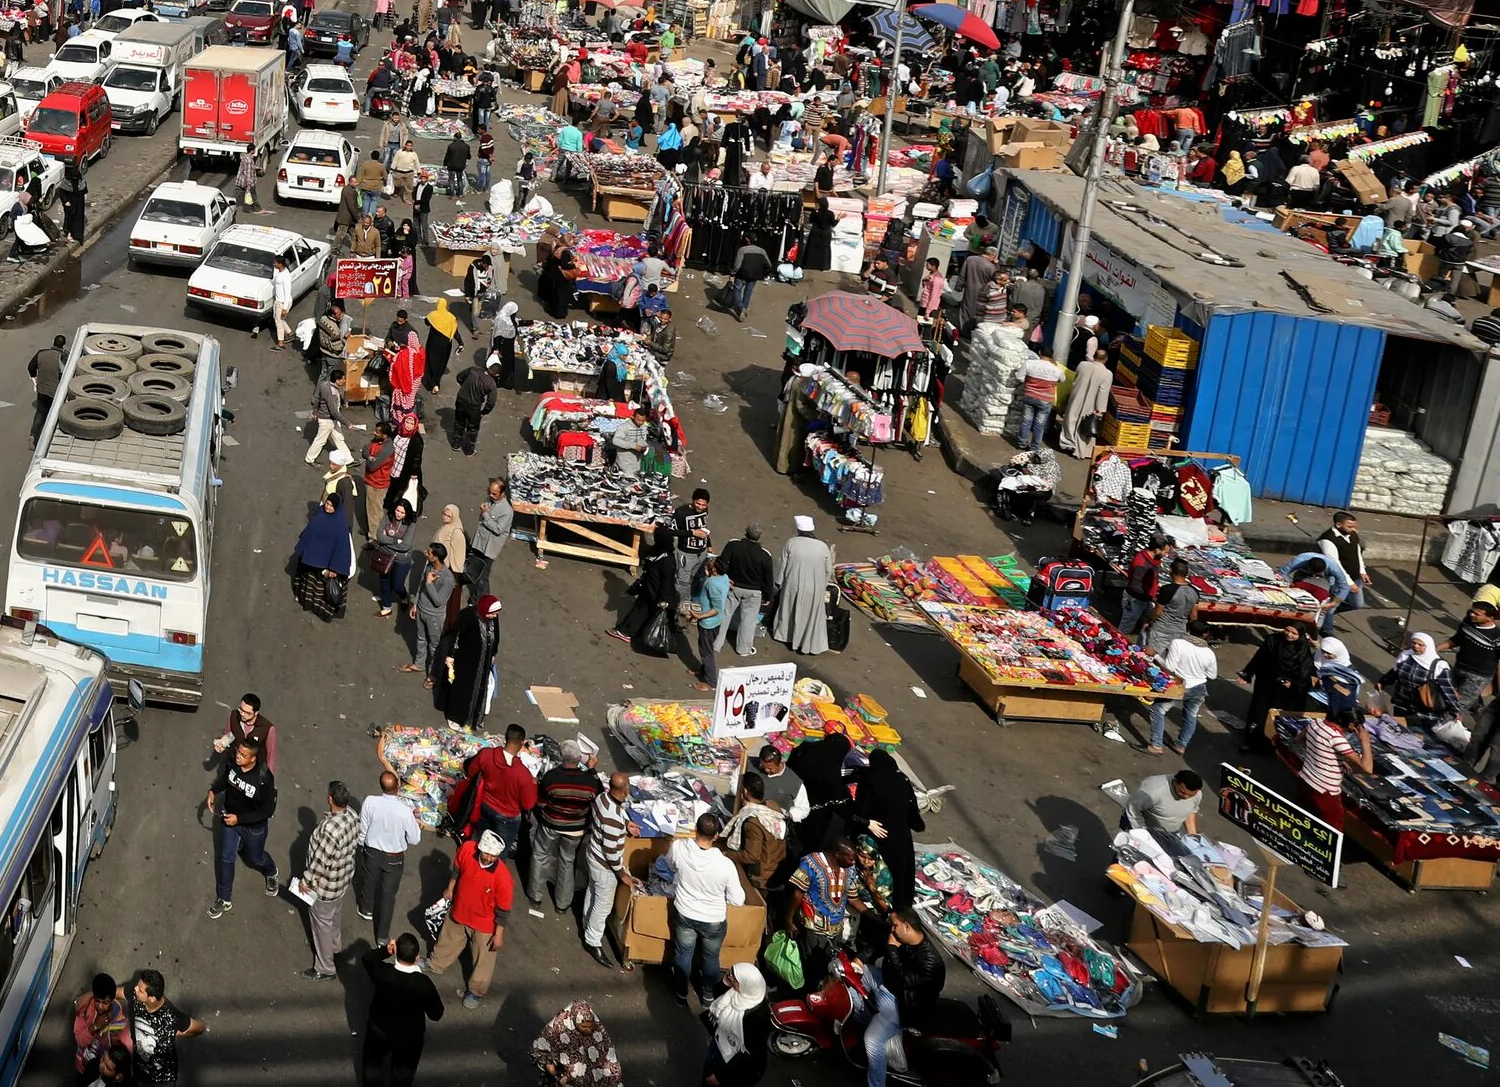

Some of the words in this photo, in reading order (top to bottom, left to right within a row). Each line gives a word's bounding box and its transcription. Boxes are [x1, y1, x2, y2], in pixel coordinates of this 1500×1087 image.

[372, 275, 392, 296] ٢٥
[43, 568, 168, 600] HASSAAN
[763, 671, 785, 685] قميص
[724, 684, 745, 720] ٣٥
[746, 689, 770, 699] تصدير
[1227, 775, 1270, 808] رجالي
[1272, 801, 1311, 830] قميص
[1279, 817, 1302, 840] ٣٥
[1303, 840, 1333, 863] السعر
